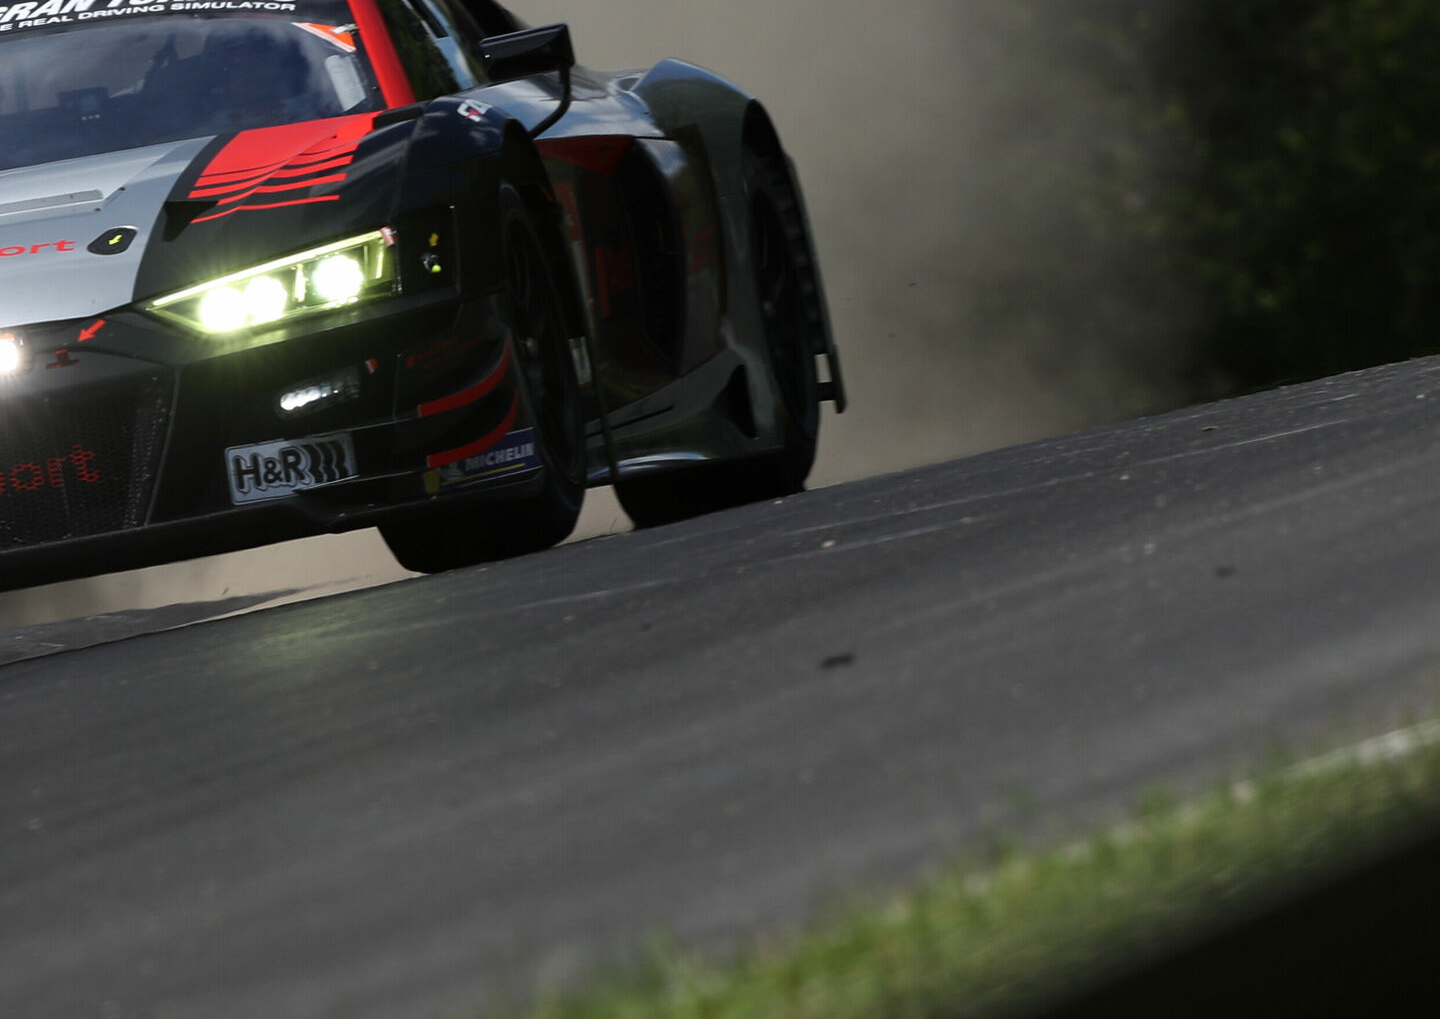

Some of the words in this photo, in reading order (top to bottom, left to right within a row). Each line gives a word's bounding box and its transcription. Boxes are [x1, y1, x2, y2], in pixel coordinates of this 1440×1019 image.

[18, 15, 74, 28] REAL
[78, 3, 166, 21] DRIVING
[171, 1, 297, 12] SIMULATOR
[234, 446, 308, 493] H&R
[464, 442, 535, 472] MICHELIN
